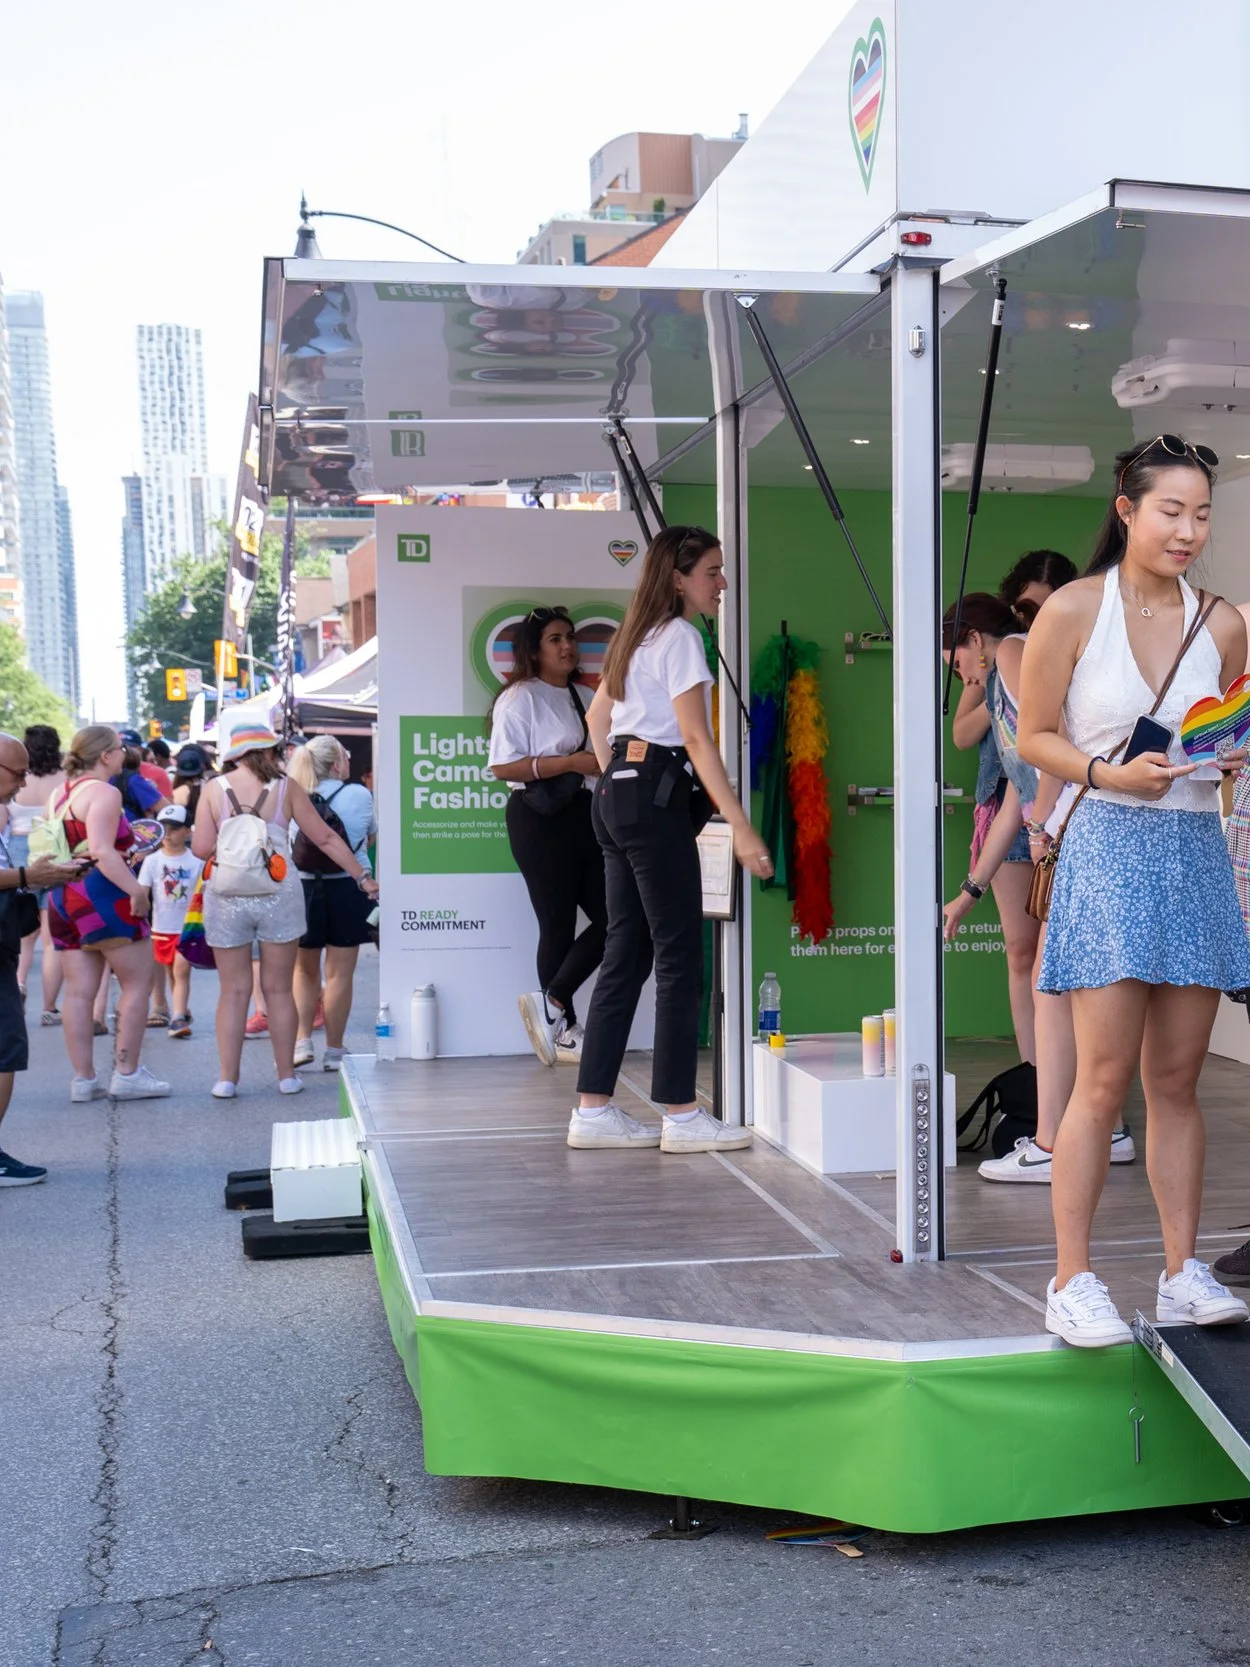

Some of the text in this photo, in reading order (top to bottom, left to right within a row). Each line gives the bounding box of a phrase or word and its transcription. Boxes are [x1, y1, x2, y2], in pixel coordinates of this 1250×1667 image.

[401, 539, 427, 557] TD
[412, 760, 497, 782] Came
[413, 786, 511, 809] Fashio
[401, 910, 458, 920] TD READY
[401, 920, 486, 931] COMMITMENT
[970, 923, 1003, 935] retur
[835, 926, 875, 940] props
[790, 943, 828, 957] them
[830, 943, 862, 956] here
[864, 943, 885, 955] for
[954, 942, 969, 953] to
[971, 939, 1007, 953] enjoy
